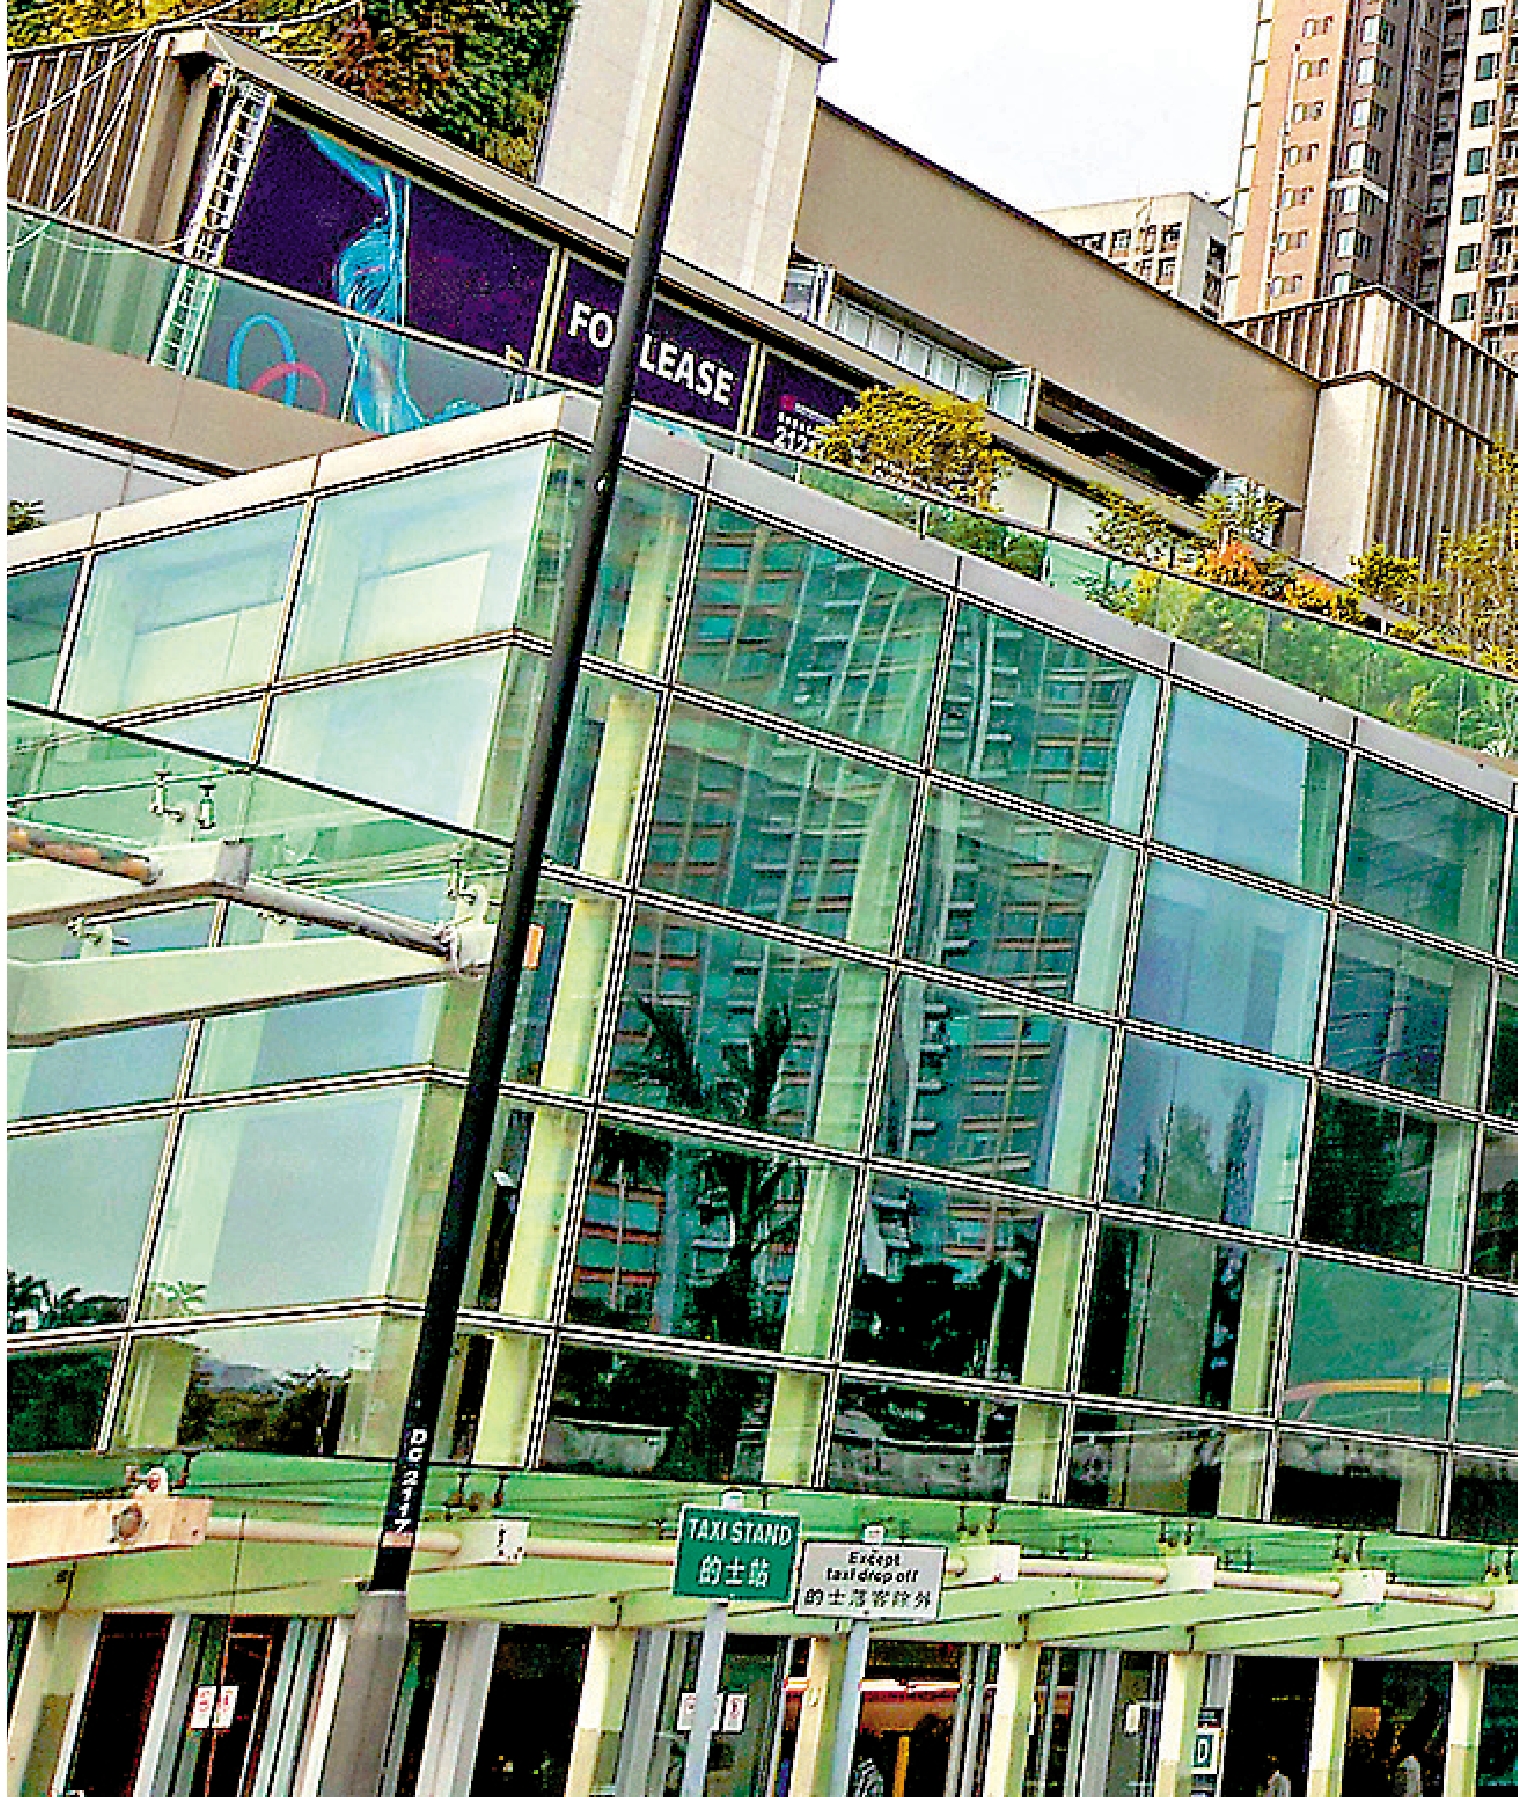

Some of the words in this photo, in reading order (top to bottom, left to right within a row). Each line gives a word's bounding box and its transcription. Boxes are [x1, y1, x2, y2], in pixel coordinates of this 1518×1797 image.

[567, 300, 614, 349] FO
[639, 334, 734, 406] LEASE
[688, 1518, 728, 1542] TAXI
[730, 1522, 793, 1547] STAND
[698, 1555, 771, 1588] 的士站
[847, 1550, 901, 1568] Except
[826, 1567, 856, 1582] taxi
[857, 1567, 893, 1585] drop
[894, 1568, 919, 1584] off
